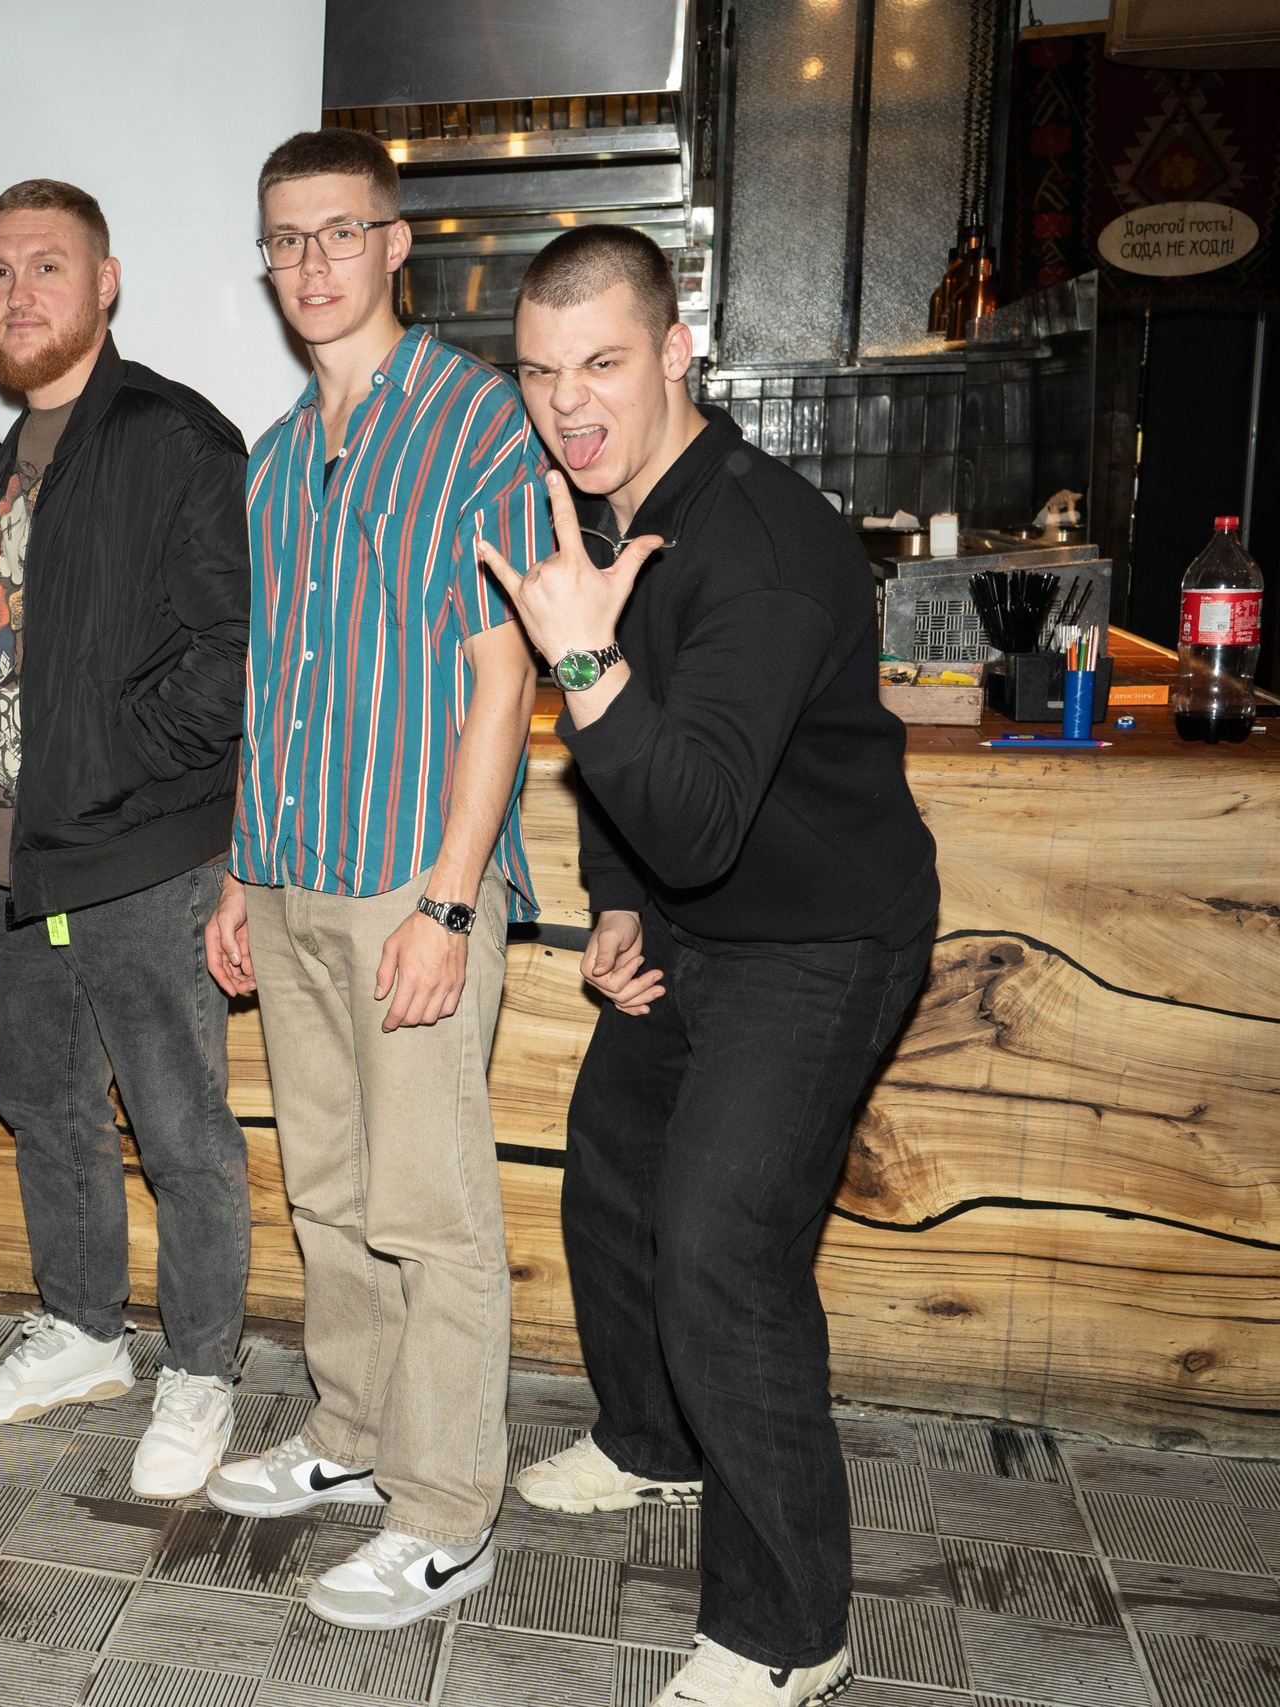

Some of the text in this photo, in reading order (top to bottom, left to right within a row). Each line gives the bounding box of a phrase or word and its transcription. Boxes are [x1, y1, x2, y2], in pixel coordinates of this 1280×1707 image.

[1124, 216, 1234, 238] Дорогой гость!
[1120, 239, 1235, 260] СЮДА НЕ ХОДИ!
